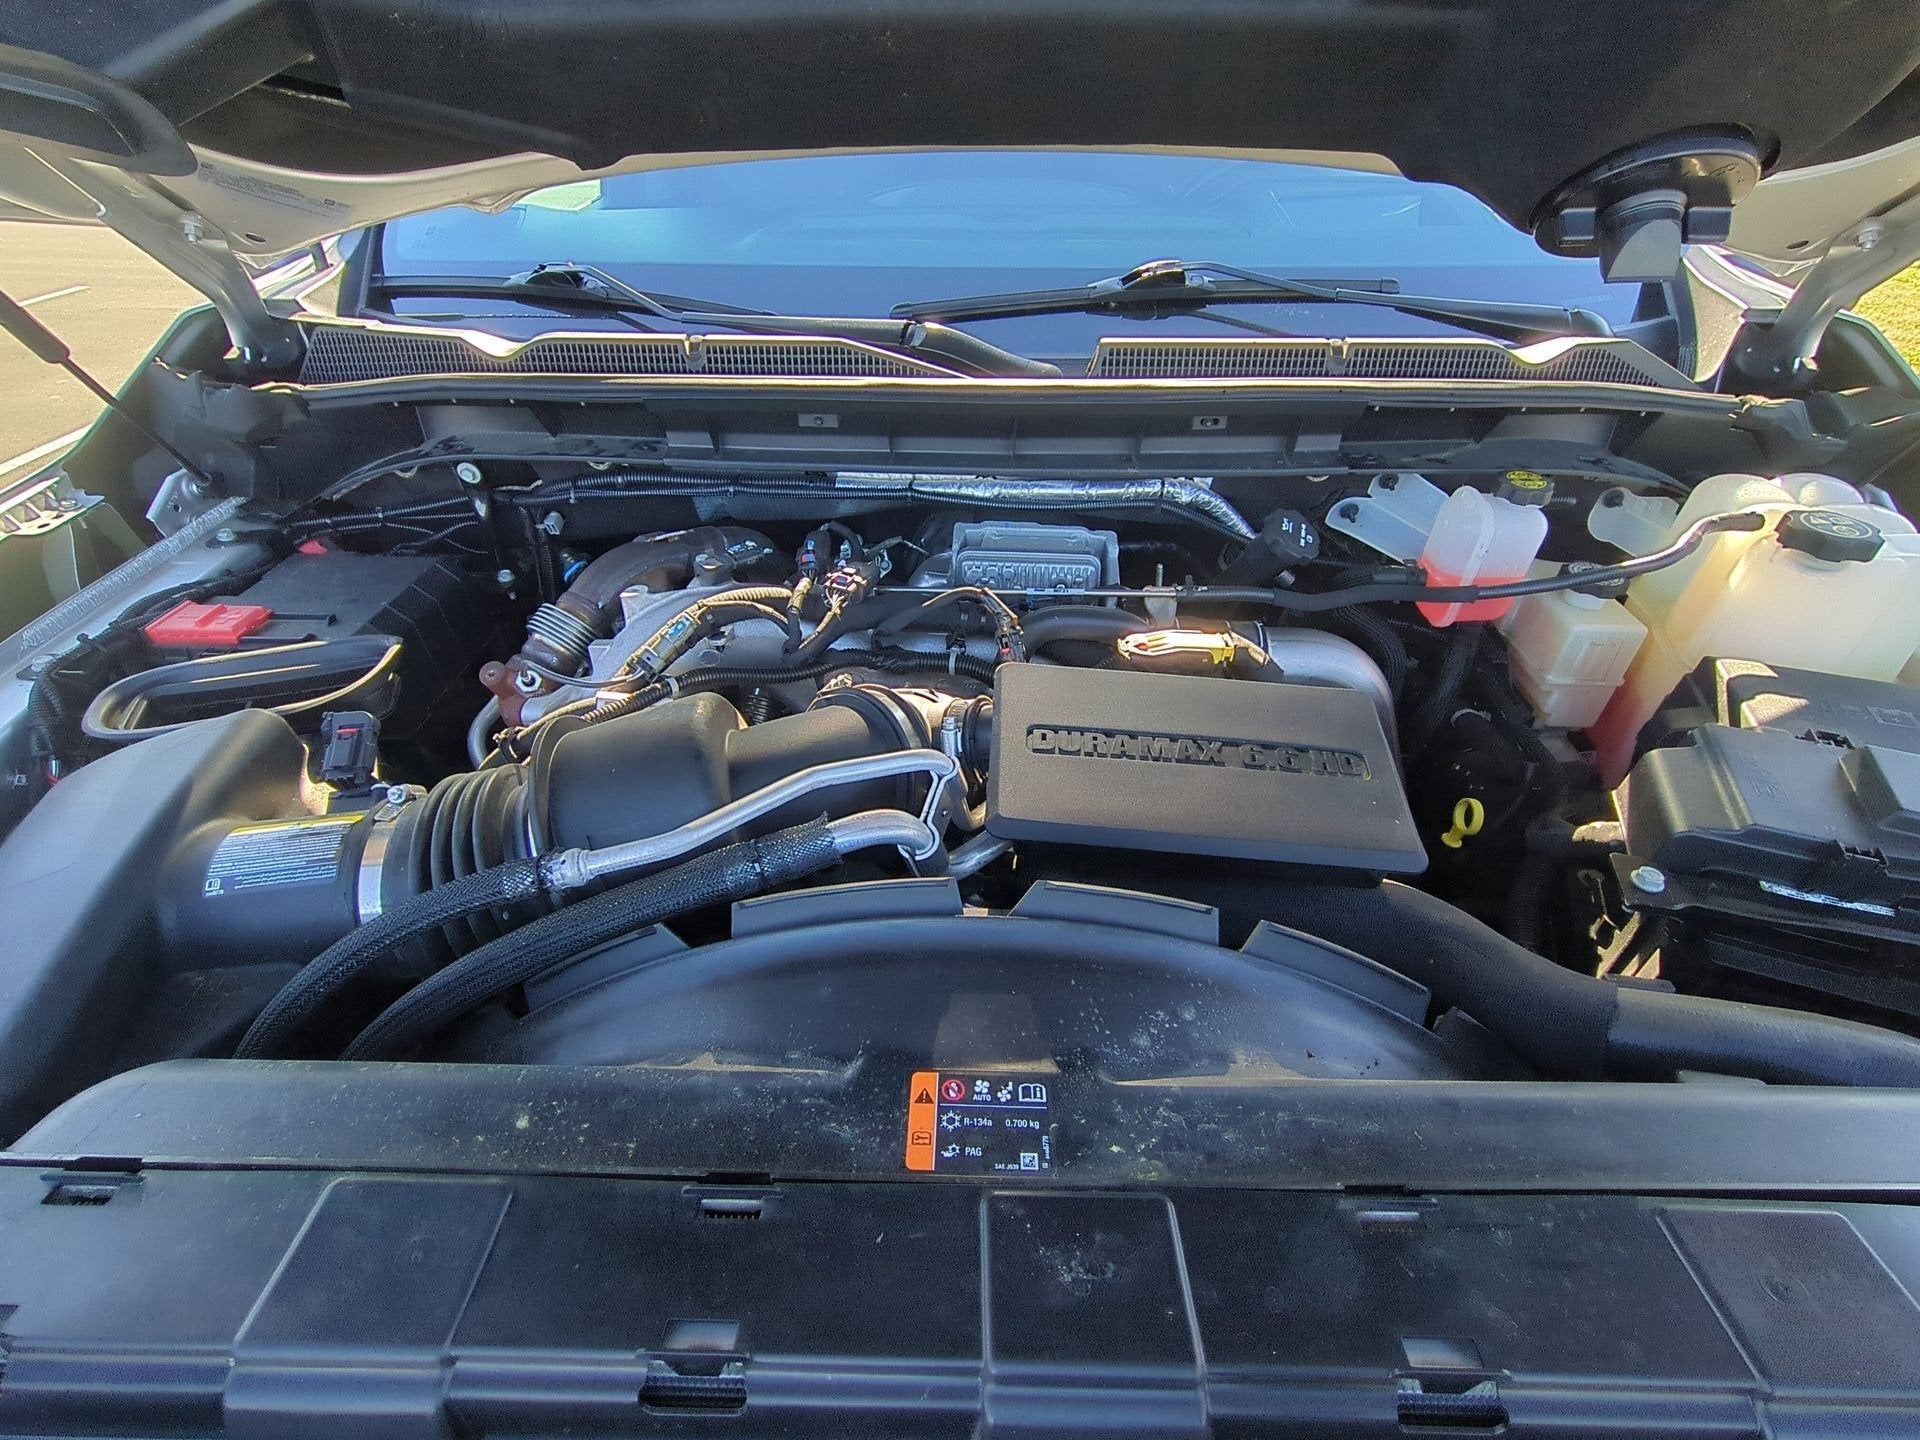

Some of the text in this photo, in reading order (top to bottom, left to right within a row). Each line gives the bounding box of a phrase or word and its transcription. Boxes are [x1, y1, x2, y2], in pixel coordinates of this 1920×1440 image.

[1030, 729, 1226, 766] DURAMAX
[1240, 743, 1303, 774] 6.6
[964, 1118, 1040, 1129] R-134a 0.700 kg
[965, 1147, 982, 1156] PAG
